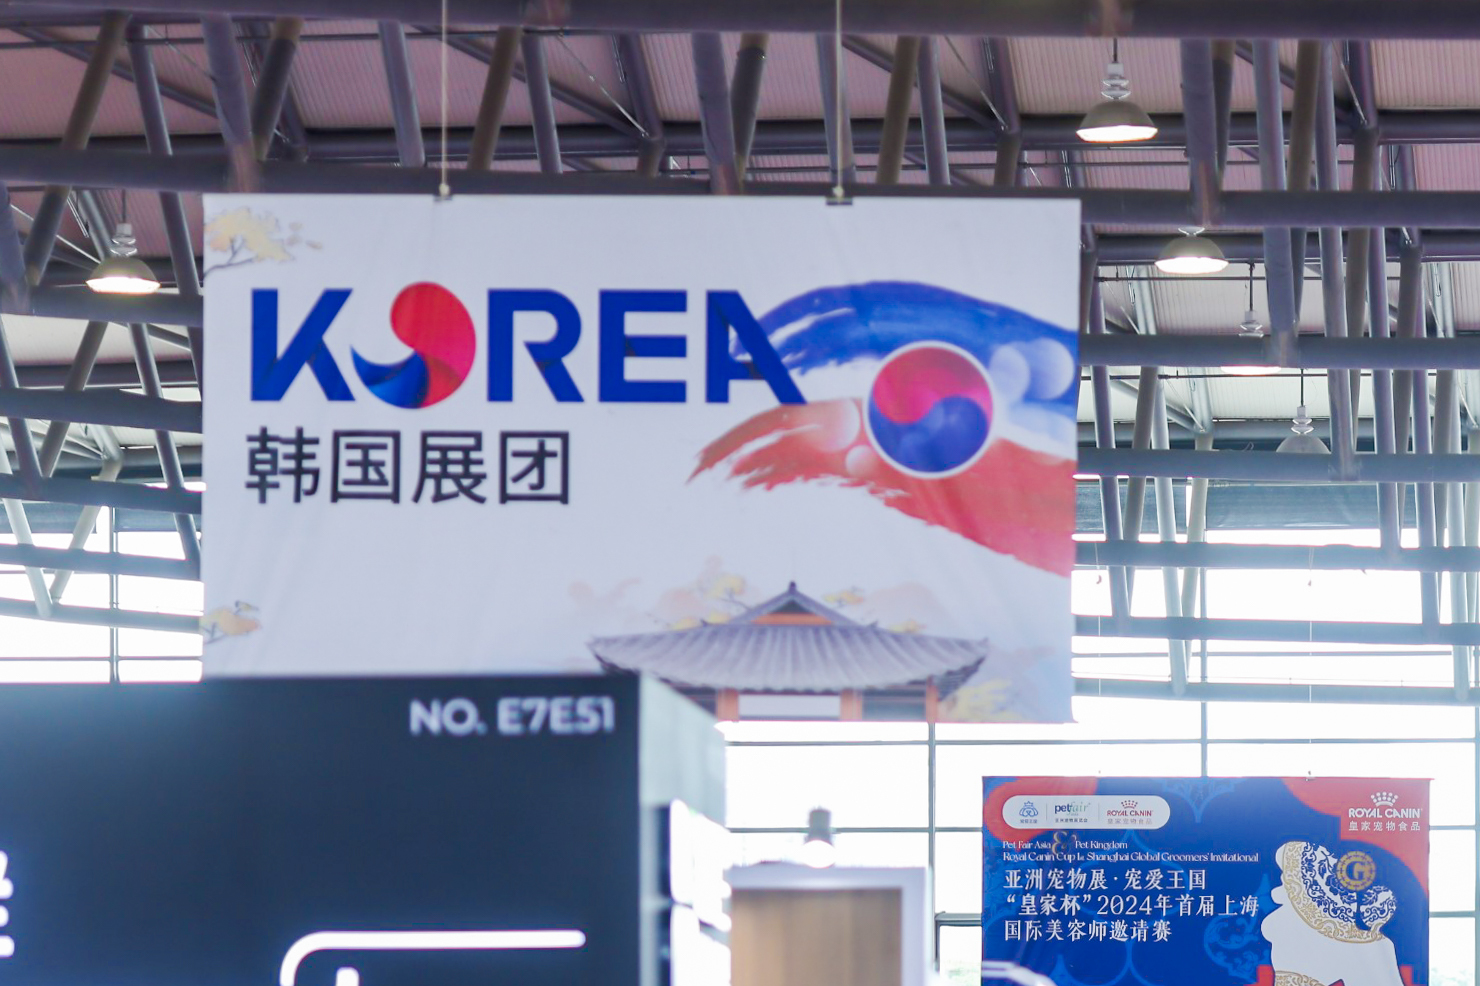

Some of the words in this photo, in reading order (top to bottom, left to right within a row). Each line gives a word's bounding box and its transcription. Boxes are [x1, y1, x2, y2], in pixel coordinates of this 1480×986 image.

[250, 281, 808, 409] KOREA
[246, 427, 571, 505] 韩国展团
[410, 697, 488, 737] NO.
[497, 696, 615, 736] E7E51
[1348, 808, 1383, 818] ROYAL
[1384, 808, 1421, 818] CANIN
[1348, 821, 1421, 831] 皇家宠物食品
[1002, 840, 1017, 849] Pet
[1018, 840, 1034, 849] Fair
[1034, 840, 1052, 849] Asia
[1075, 840, 1089, 849] Pet
[1090, 840, 1128, 851] Kingdom
[1003, 851, 1027, 862] Royal
[1028, 852, 1055, 861] Canin
[1056, 852, 1076, 864] Cup
[1086, 851, 1130, 863] Shanghai
[1130, 852, 1160, 861] Global
[1210, 852, 1259, 863] Invitational
[1005, 919, 1172, 942] 国际美容师邀请赛
